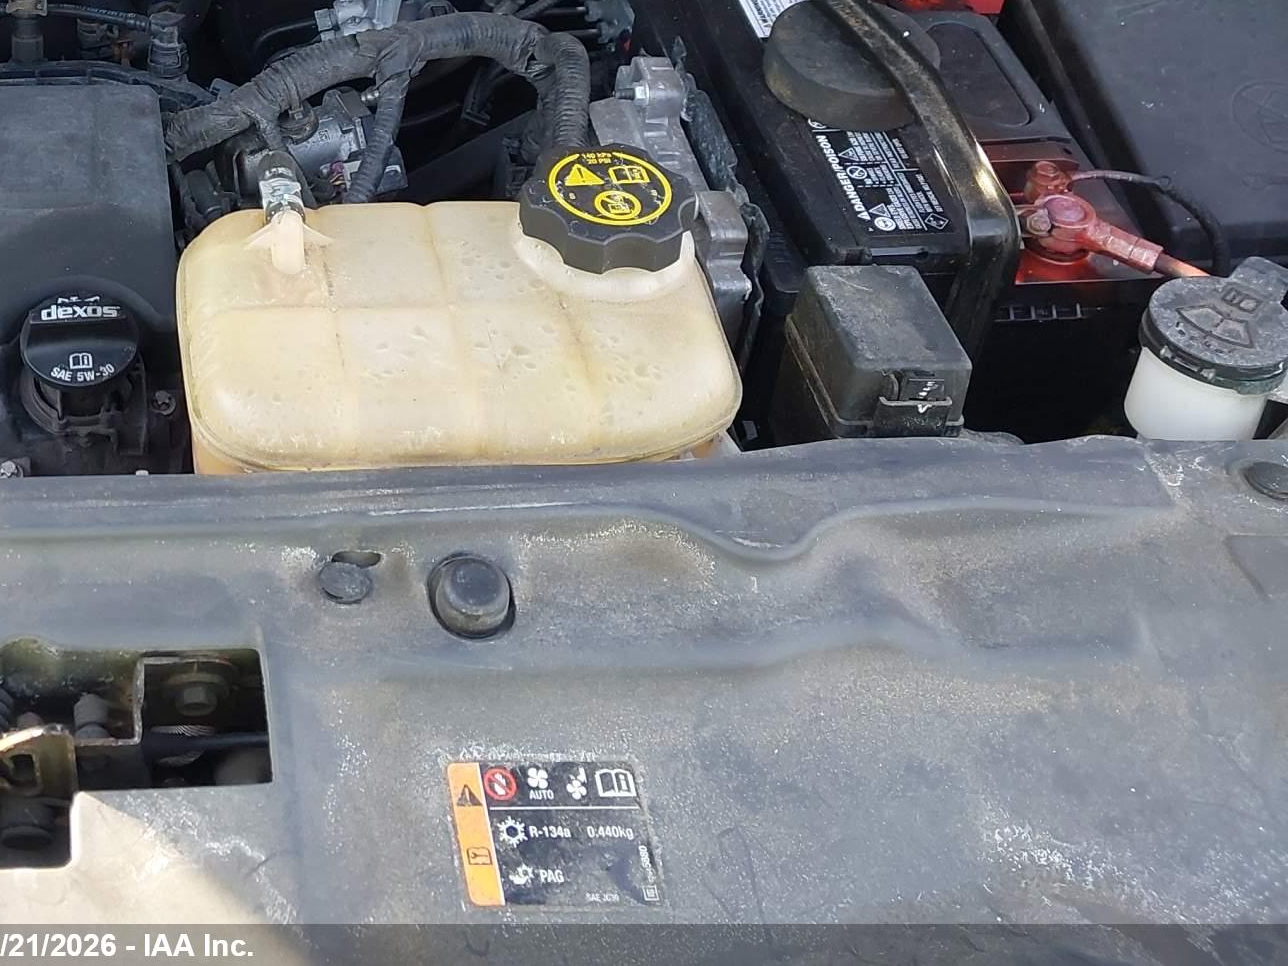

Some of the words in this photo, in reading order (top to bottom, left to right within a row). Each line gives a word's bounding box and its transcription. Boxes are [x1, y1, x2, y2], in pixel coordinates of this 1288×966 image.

[816, 135, 865, 211] DANGER/POISON
[40, 304, 120, 321] dexos
[51, 366, 72, 382] SAE
[76, 363, 115, 382] 5W-30
[529, 789, 554, 800] AUTO
[528, 826, 571, 839] R-134a
[586, 826, 634, 840] 0.440kg
[539, 869, 565, 883] PAG
